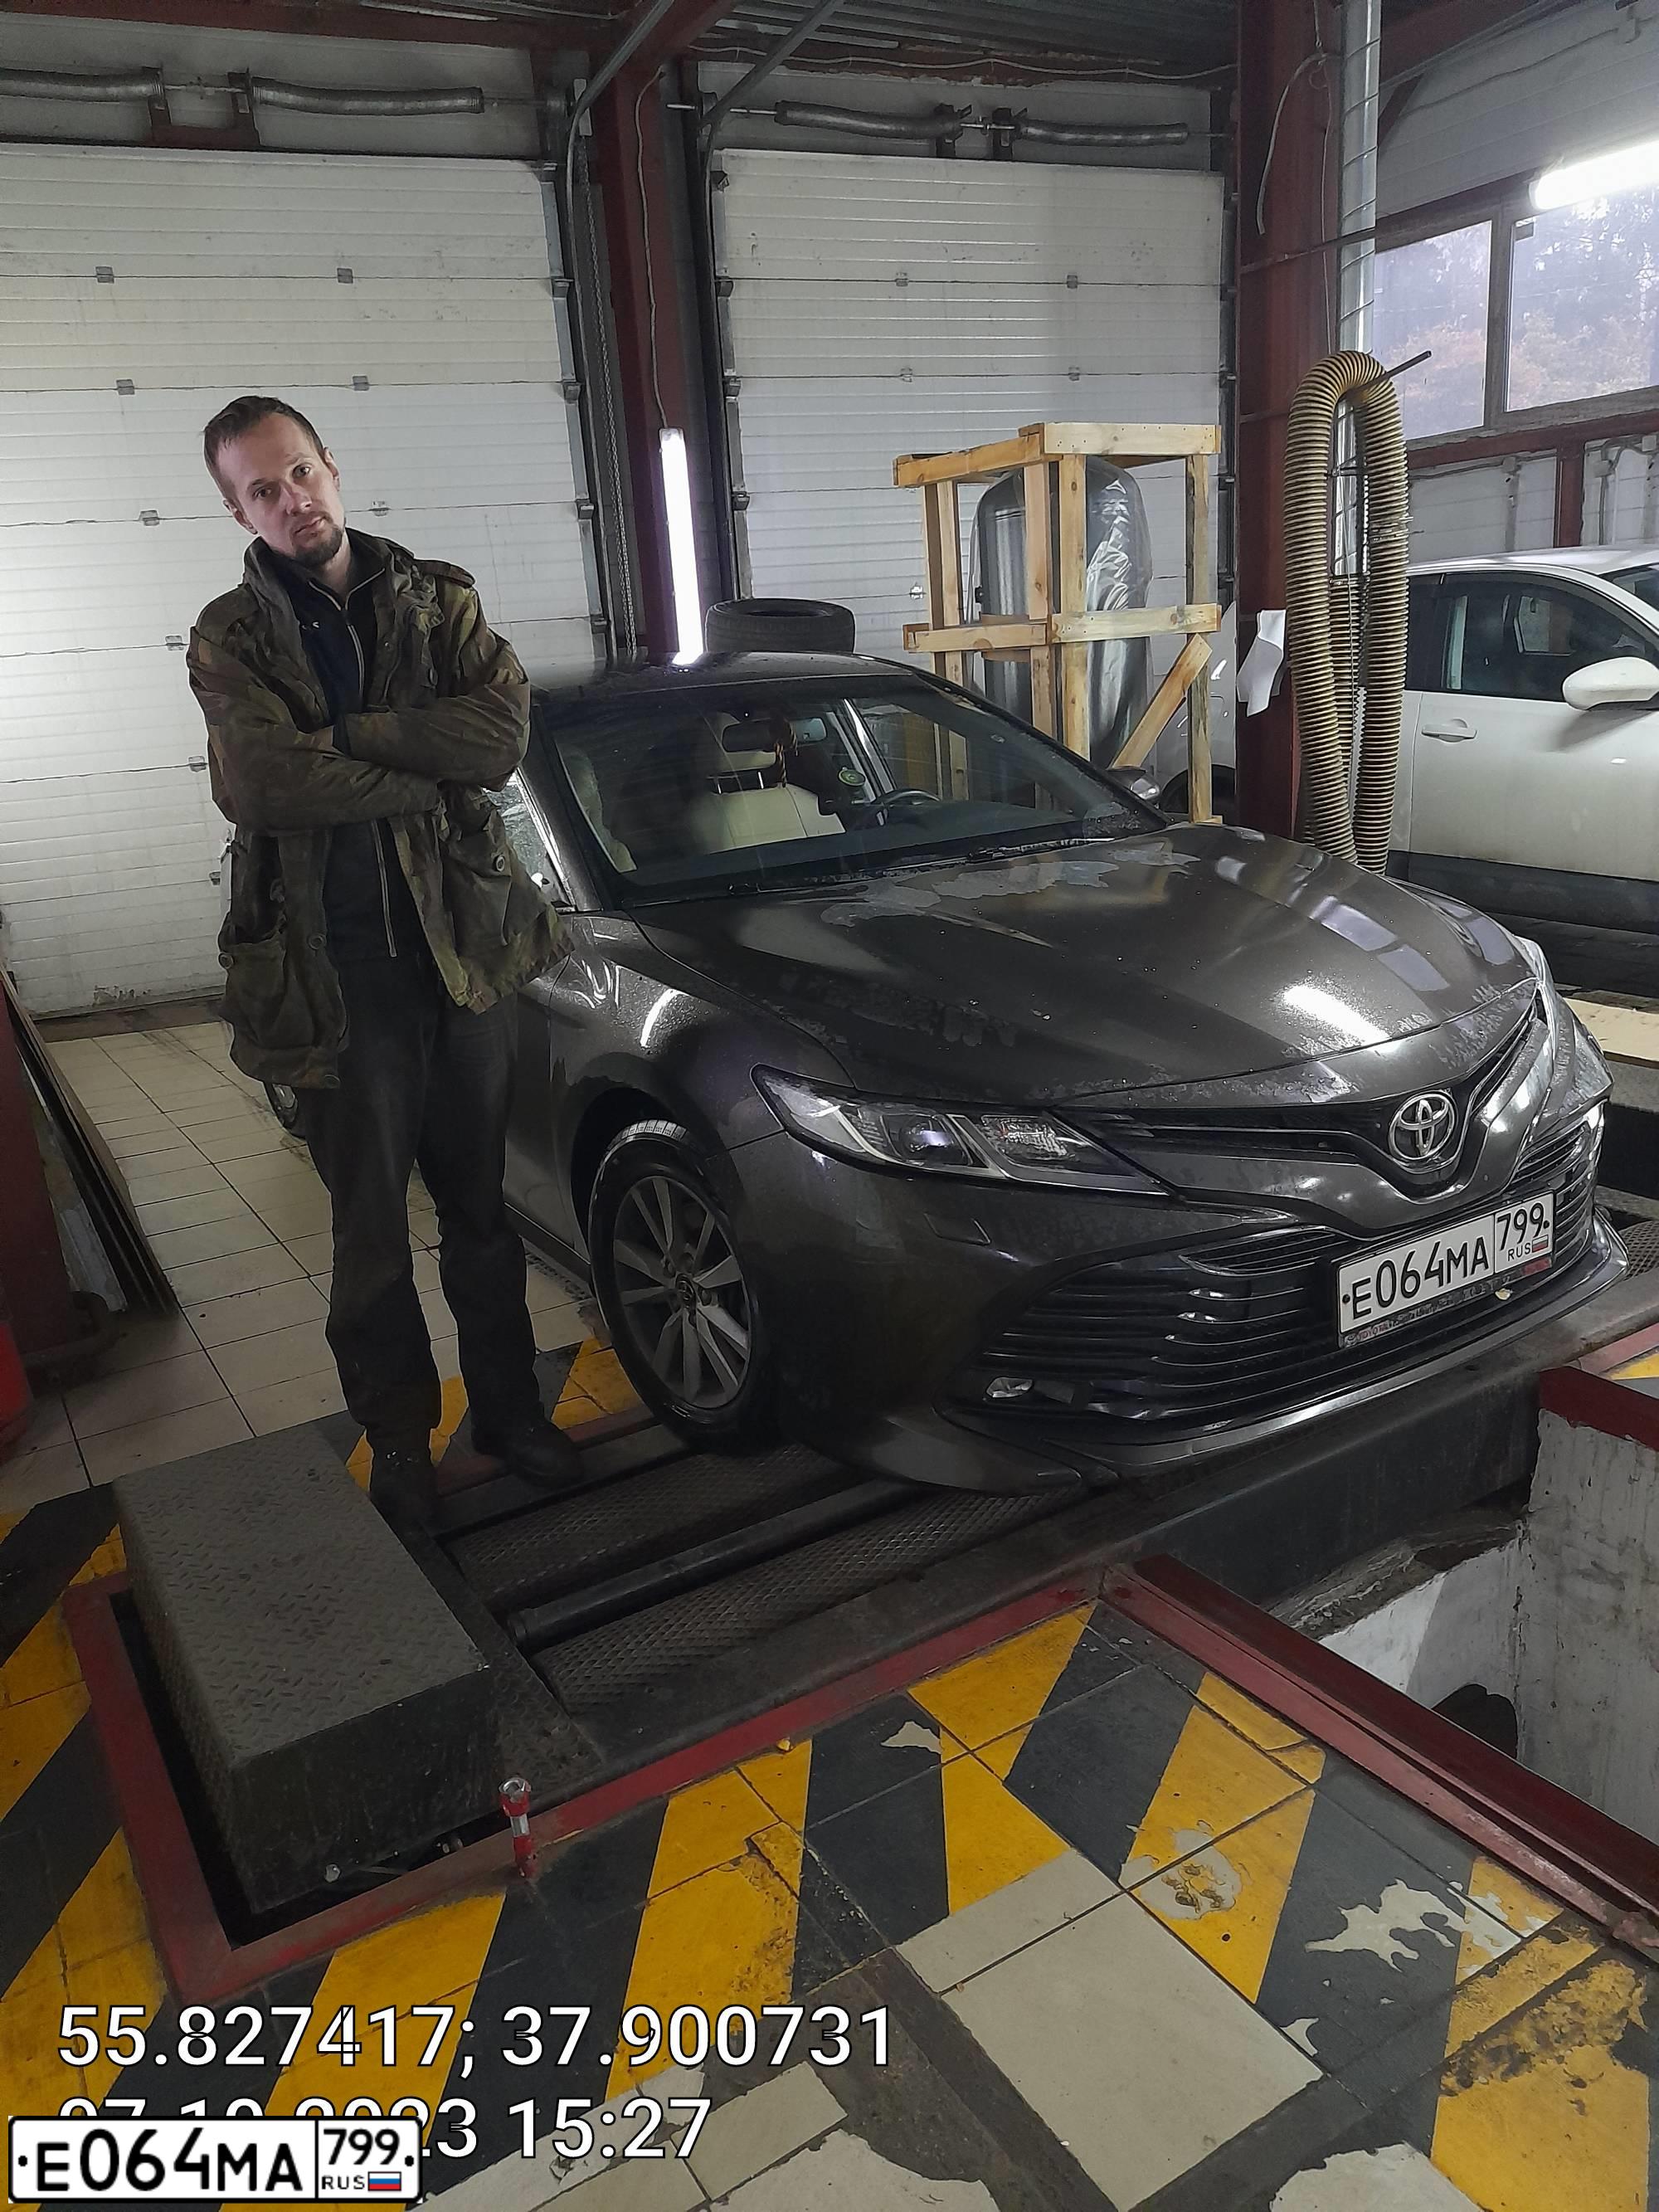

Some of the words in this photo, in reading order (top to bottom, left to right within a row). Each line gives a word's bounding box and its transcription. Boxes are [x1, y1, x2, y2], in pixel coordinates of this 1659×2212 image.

[1352, 1237, 1489, 1320] E064MA
[1496, 1202, 1545, 1251] 799
[1507, 1241, 1531, 1262] RUS
